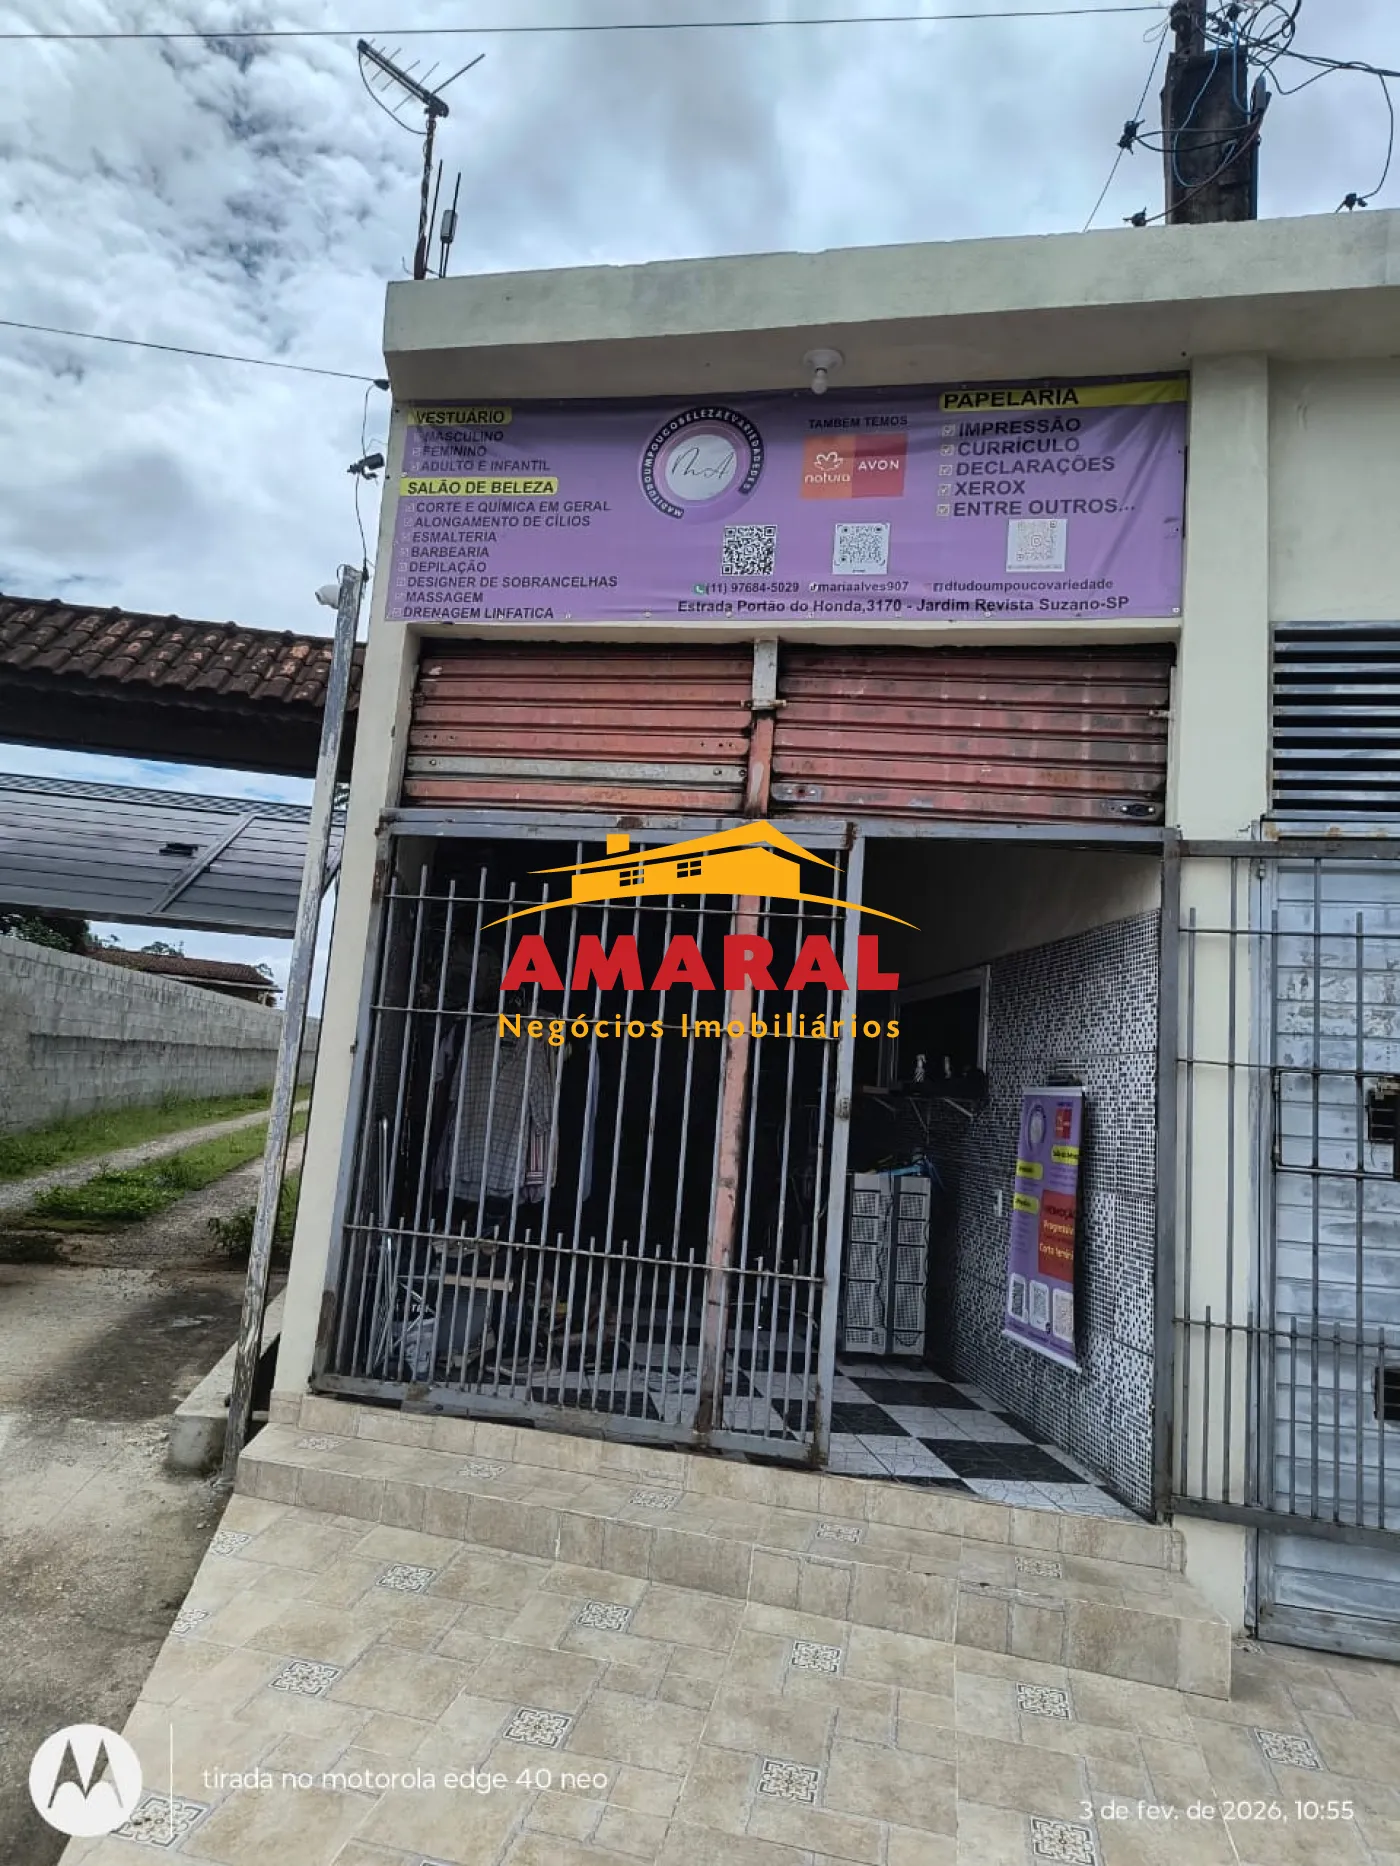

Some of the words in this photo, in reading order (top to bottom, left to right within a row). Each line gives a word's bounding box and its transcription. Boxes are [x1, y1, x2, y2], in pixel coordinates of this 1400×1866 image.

[944, 388, 1079, 409] PAPELARIA
[416, 407, 504, 424] VESTUÁRIO
[865, 415, 908, 427] TEMOS
[958, 417, 1081, 437] IMPRESSÃO
[423, 430, 504, 442] MASCULINO
[423, 445, 488, 457] FEMININO
[957, 437, 1080, 456] CURRÍCULO
[421, 460, 474, 472] ADULTO
[478, 461, 486, 471] E
[490, 460, 550, 471] INFANTIL
[858, 460, 900, 471] AVON
[956, 455, 1115, 477] DECLARAÇÕES
[805, 472, 851, 484] natura
[407, 480, 461, 495] SALÃO
[465, 481, 487, 494] DE
[491, 480, 554, 494] BELEZA
[954, 480, 1026, 496] XEROX
[416, 502, 461, 513] CORTE
[465, 502, 474, 513] E
[478, 499, 535, 513] QUÍMICA
[539, 501, 560, 512] EM
[563, 500, 612, 512] GERAL
[953, 501, 1022, 517] ENTRE
[1029, 499, 1136, 515] OUTROS...
[413, 515, 519, 527] ALONGAMENTO
[523, 515, 541, 527] DE
[545, 513, 591, 527] CÍLIOS
[412, 531, 497, 543] ESMALTERIA
[410, 547, 489, 558] BARBEARIA
[409, 560, 487, 573] DEPILAÇÃO
[407, 576, 476, 588] DESIGNER
[479, 576, 498, 588] DE
[502, 575, 618, 588] SOBRANCELHAS
[706, 582, 727, 595] (11)
[406, 591, 484, 603] MASSAGEM
[677, 601, 733, 613] Estrada
[737, 600, 786, 613] Portão
[790, 600, 808, 613] do
[916, 598, 970, 612] Jardim
[975, 597, 1035, 612] Revista
[1039, 595, 1130, 611] Suzano-SP
[403, 606, 481, 619] DRENAGEM
[484, 607, 554, 619] LINFATICA
